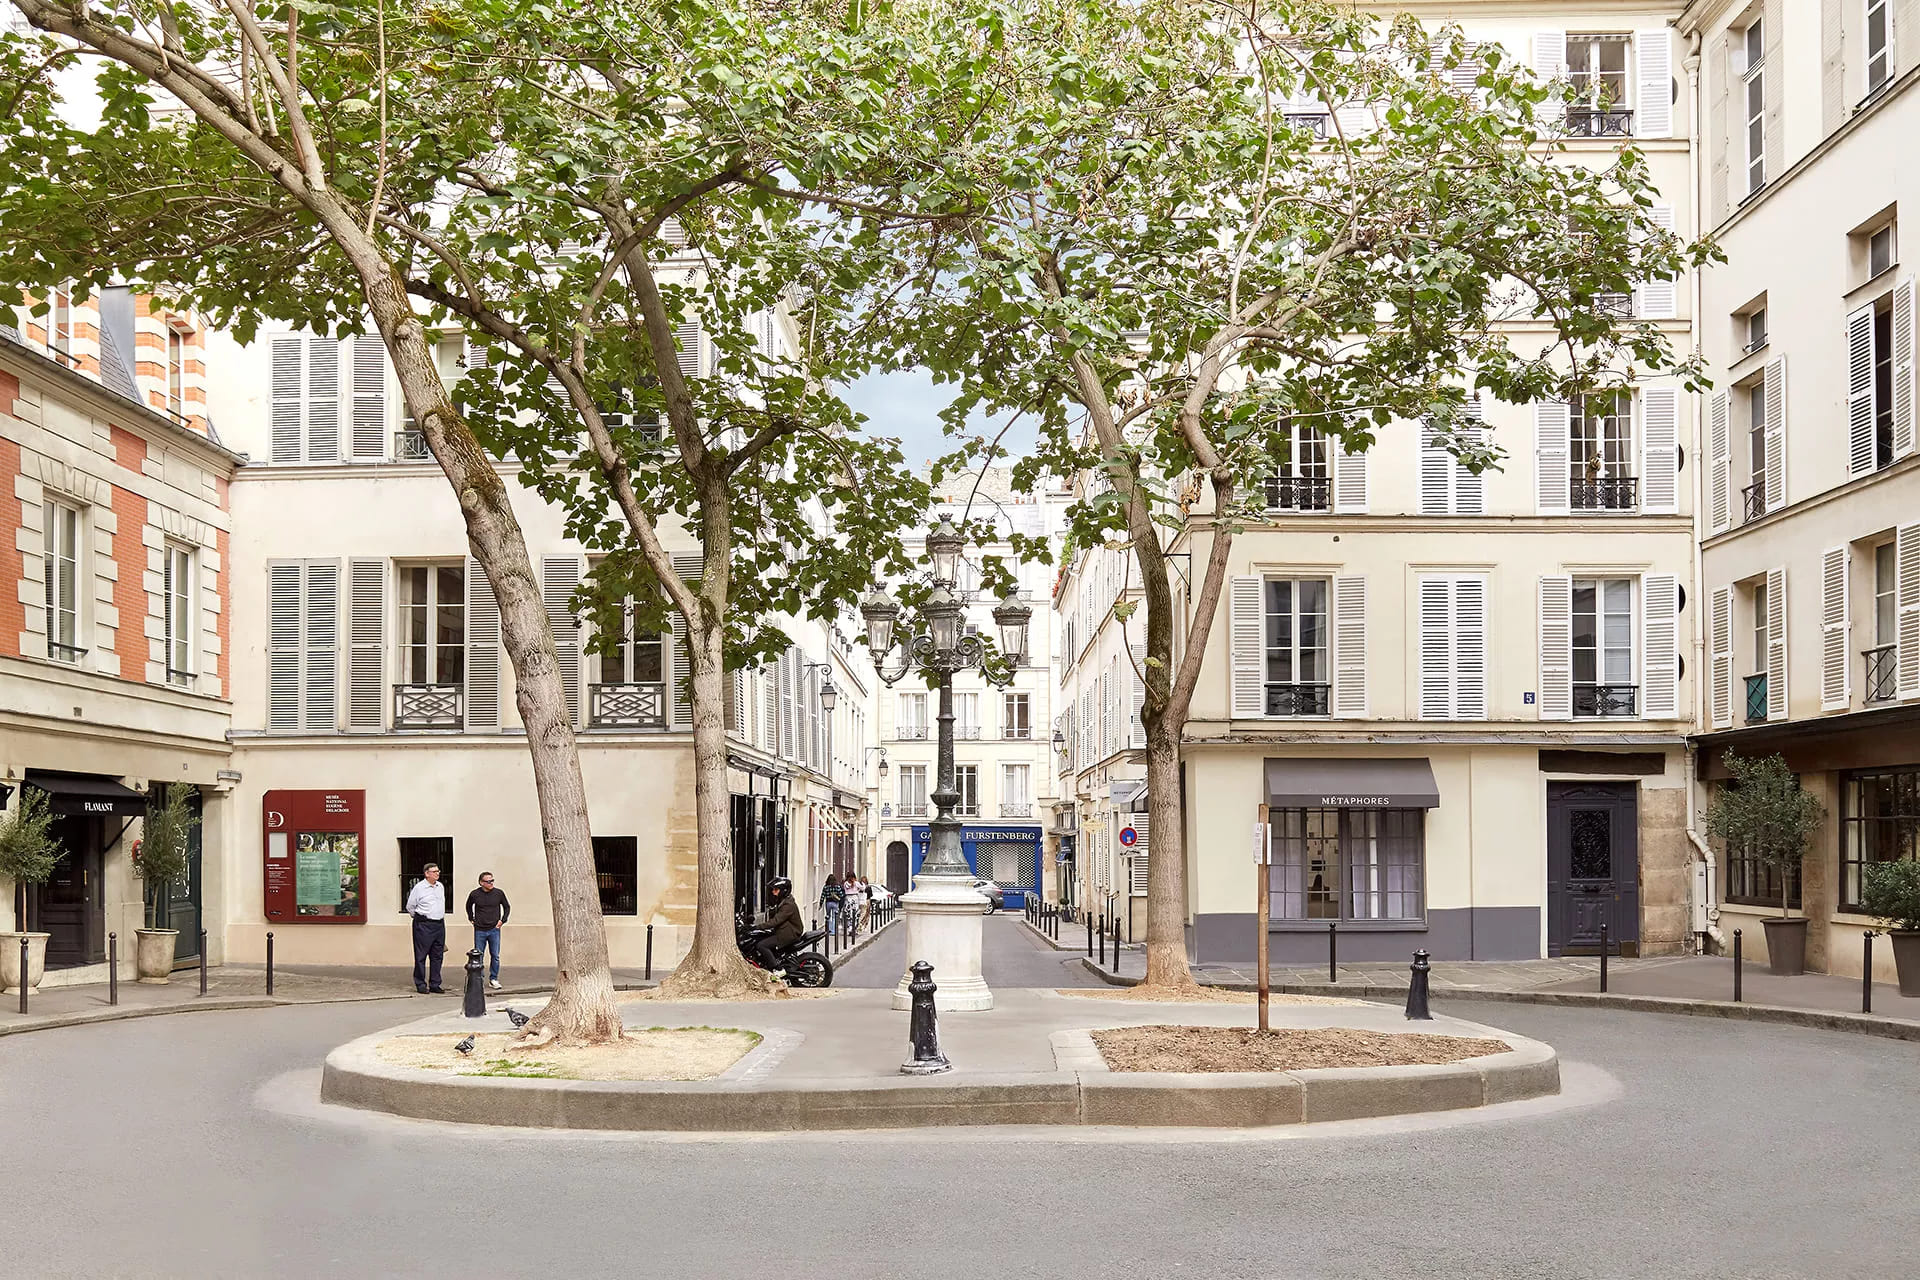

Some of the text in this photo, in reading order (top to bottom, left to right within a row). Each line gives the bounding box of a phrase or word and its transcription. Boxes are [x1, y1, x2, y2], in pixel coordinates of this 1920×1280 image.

[1526, 694, 1533, 703] 5
[1321, 795, 1390, 805] MÉTAPHORES
[965, 831, 1035, 840] FURSTENBERG
